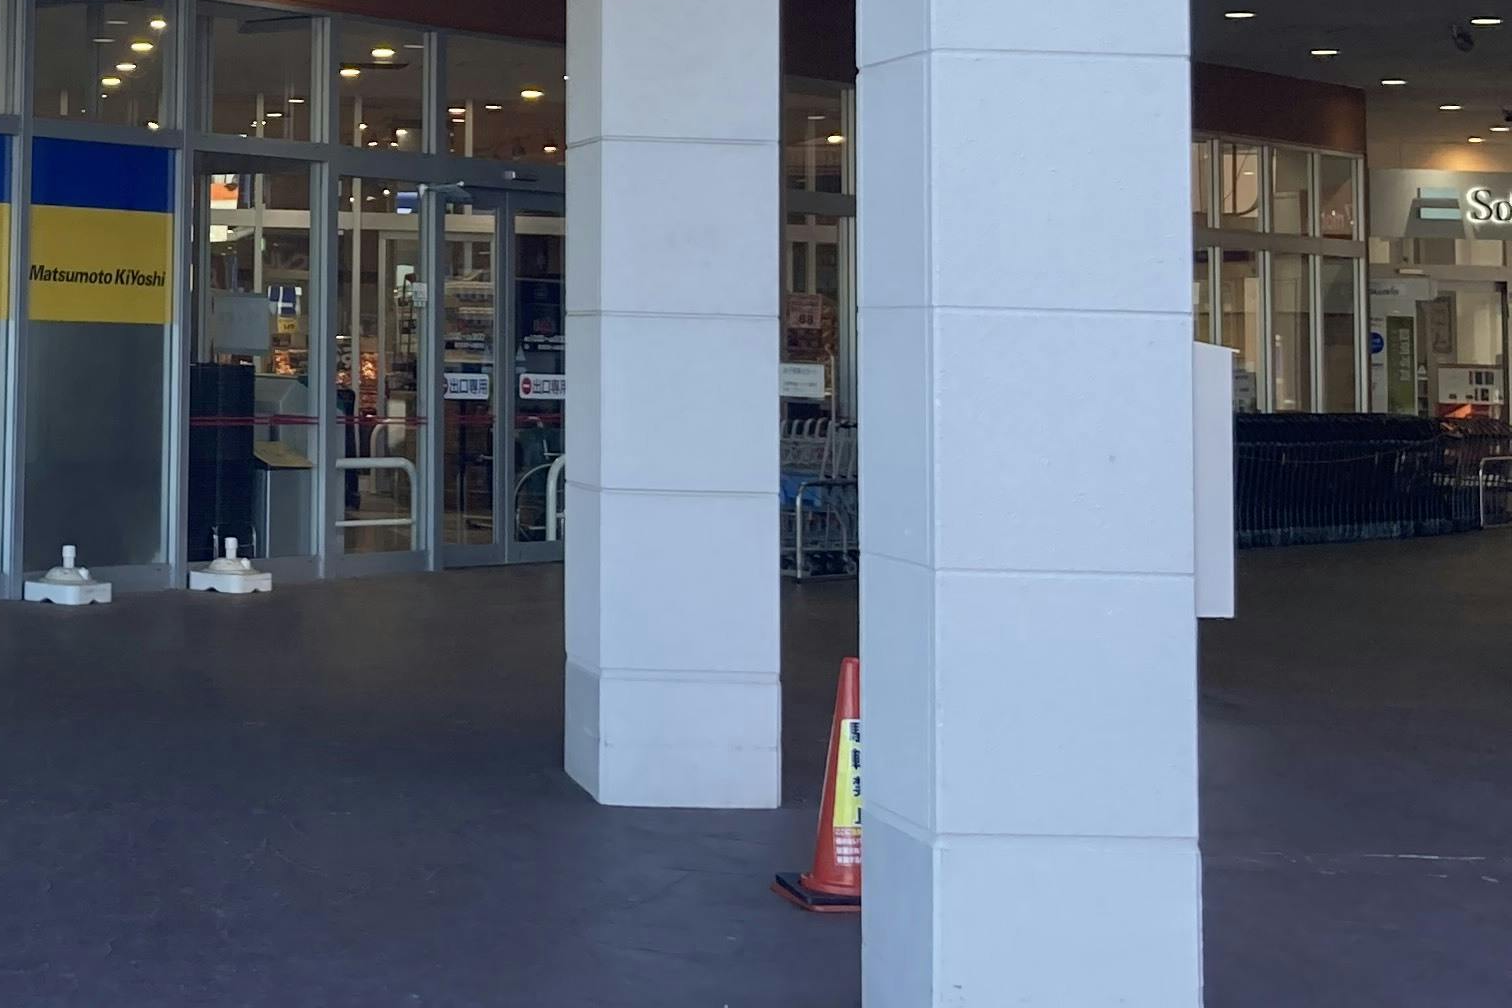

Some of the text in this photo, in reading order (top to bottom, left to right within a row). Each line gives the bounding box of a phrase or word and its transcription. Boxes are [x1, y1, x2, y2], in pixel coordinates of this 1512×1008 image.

[29, 264, 166, 287] Matsumoto KiYoshi
[449, 378, 488, 394] 出口専用
